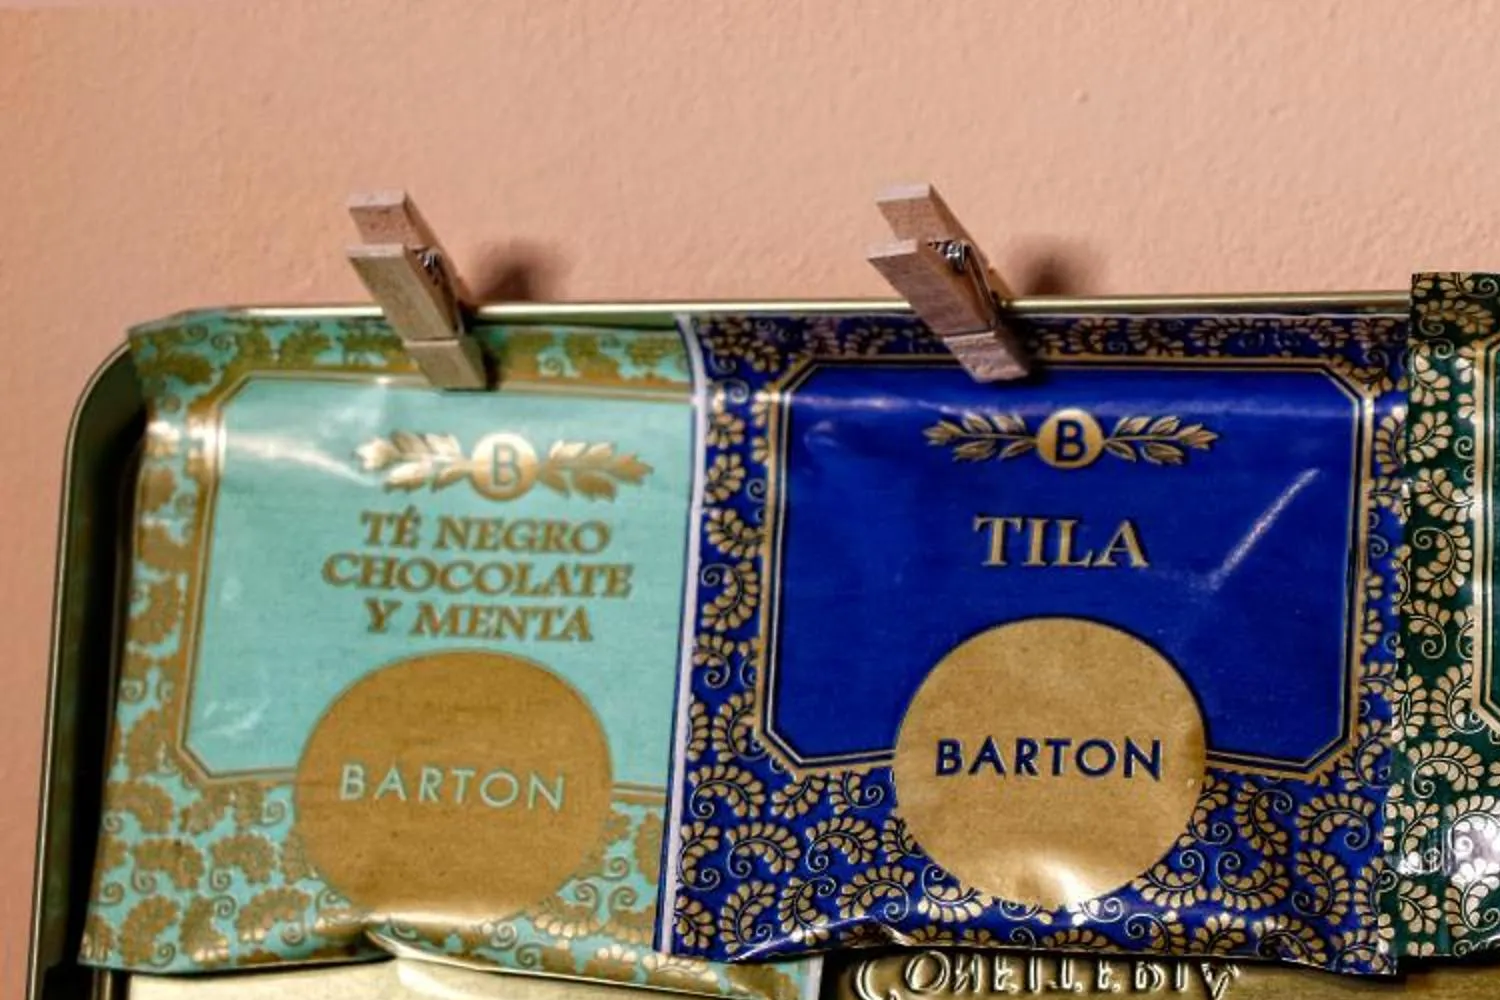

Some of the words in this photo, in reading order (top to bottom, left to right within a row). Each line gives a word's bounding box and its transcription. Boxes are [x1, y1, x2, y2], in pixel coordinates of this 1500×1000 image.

[1055, 420, 1087, 460] B
[490, 445, 517, 486] B
[360, 505, 421, 548] TÉ
[432, 516, 612, 555] NEGRO
[972, 516, 1150, 568] TILA
[322, 553, 634, 600] CHOCOLATE
[364, 601, 400, 633] Y
[411, 603, 593, 642] MENTA
[934, 735, 1163, 781] BARTON
[340, 763, 566, 812] BARTON
